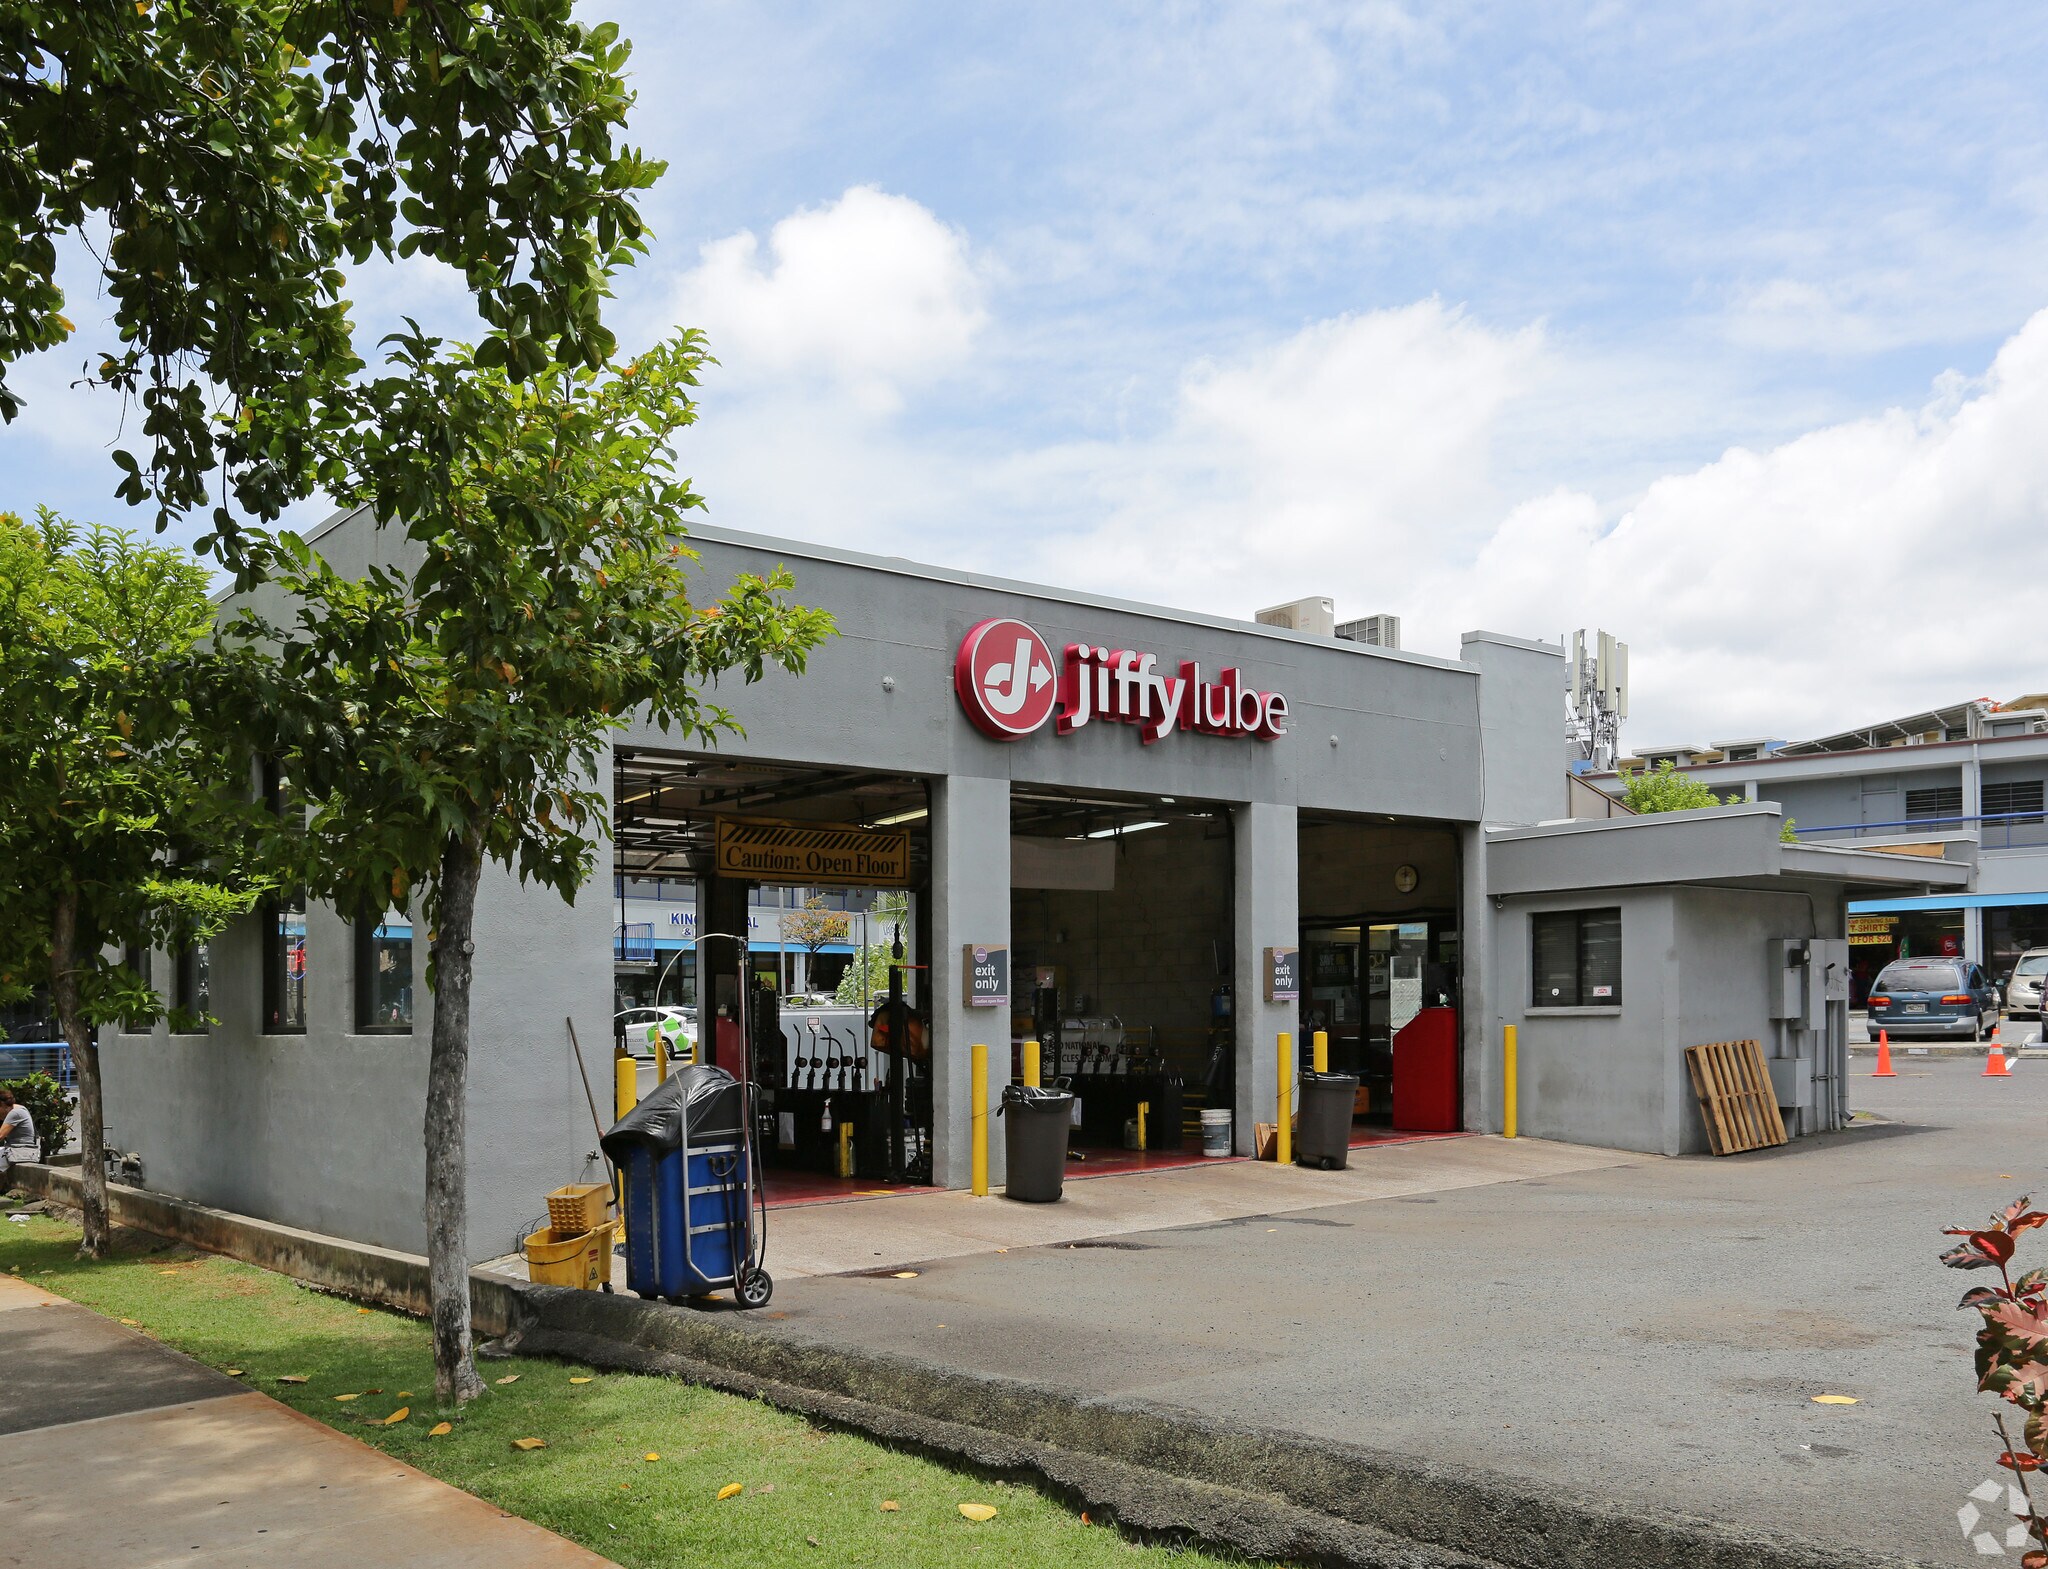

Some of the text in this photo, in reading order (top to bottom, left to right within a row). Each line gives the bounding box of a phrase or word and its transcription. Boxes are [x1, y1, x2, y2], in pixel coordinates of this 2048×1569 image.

[1070, 643, 1289, 739] jiffy lube
[725, 846, 899, 875] Caution: Open Floor
[1849, 924, 1890, 932] T-SHIRTS
[1857, 935, 1874, 943] FOR
[1877, 934, 1892, 943] $20
[975, 963, 996, 976] exit
[1275, 963, 1291, 975] exit
[975, 976, 999, 992] only
[1275, 975, 1293, 989] only
